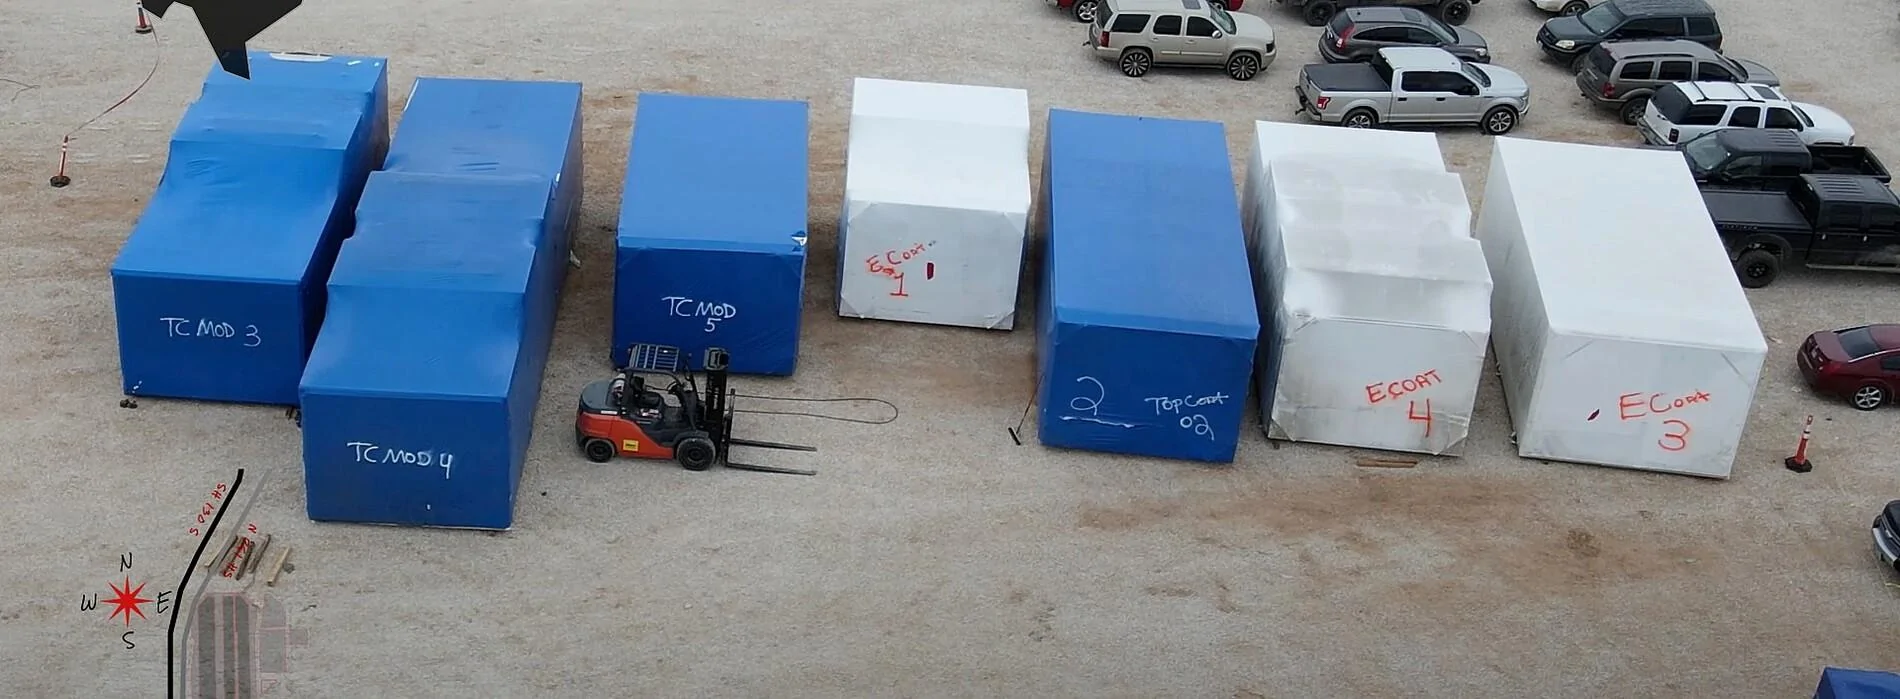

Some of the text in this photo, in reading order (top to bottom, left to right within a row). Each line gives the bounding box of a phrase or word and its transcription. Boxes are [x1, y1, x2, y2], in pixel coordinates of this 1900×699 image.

[889, 271, 909, 297] 1
[660, 296, 737, 319] TC MOD
[159, 317, 262, 347] TC MOD 3
[704, 317, 722, 333] 5
[1070, 375, 1105, 416] 2
[1365, 369, 1443, 404] ECOAT
[1179, 413, 1215, 441] 02
[1408, 397, 1432, 438] 4
[1657, 419, 1691, 451] 3
[346, 441, 454, 480] TC MOD 4
